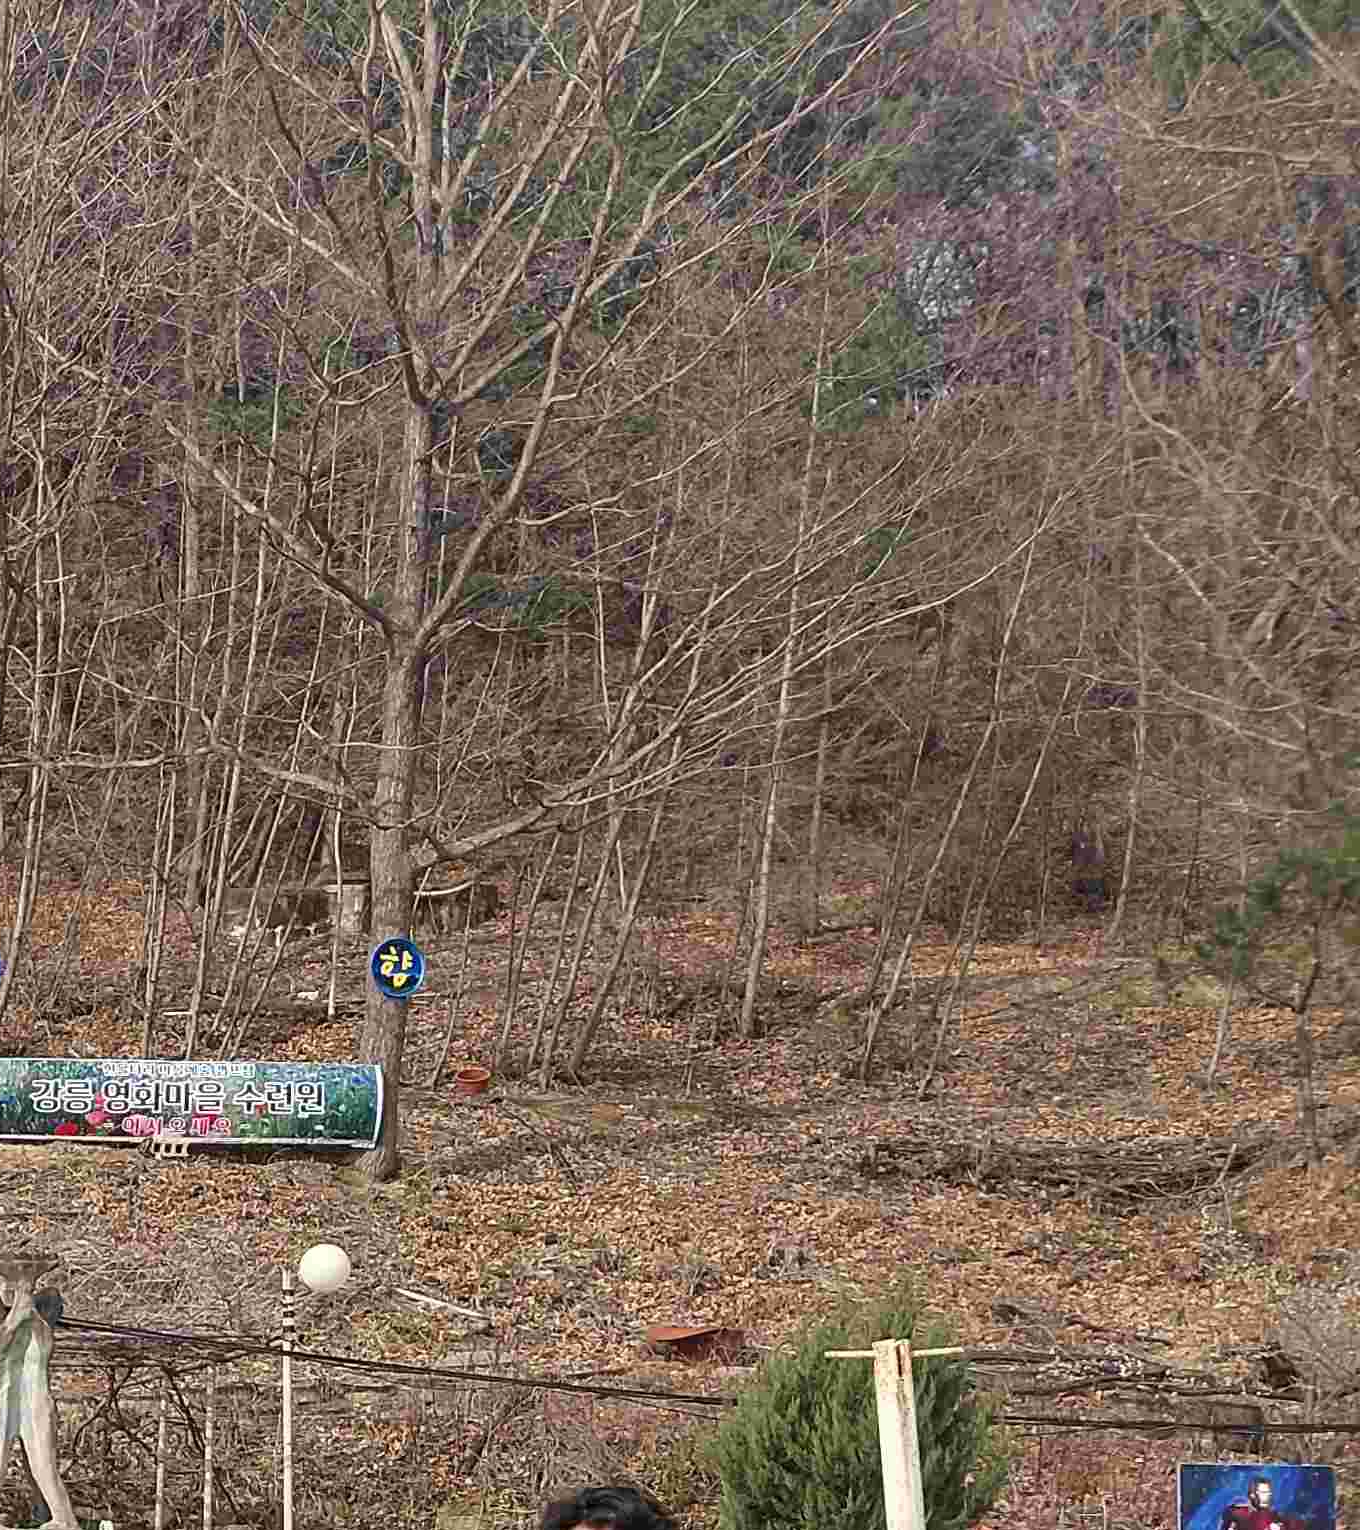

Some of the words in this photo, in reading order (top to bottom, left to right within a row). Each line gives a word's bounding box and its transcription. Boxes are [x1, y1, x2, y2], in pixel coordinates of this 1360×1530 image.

[378, 945, 416, 991] 향
[30, 1079, 98, 1113] 강릉
[102, 1080, 226, 1114] 영화마을
[231, 1081, 326, 1117] 수련원
